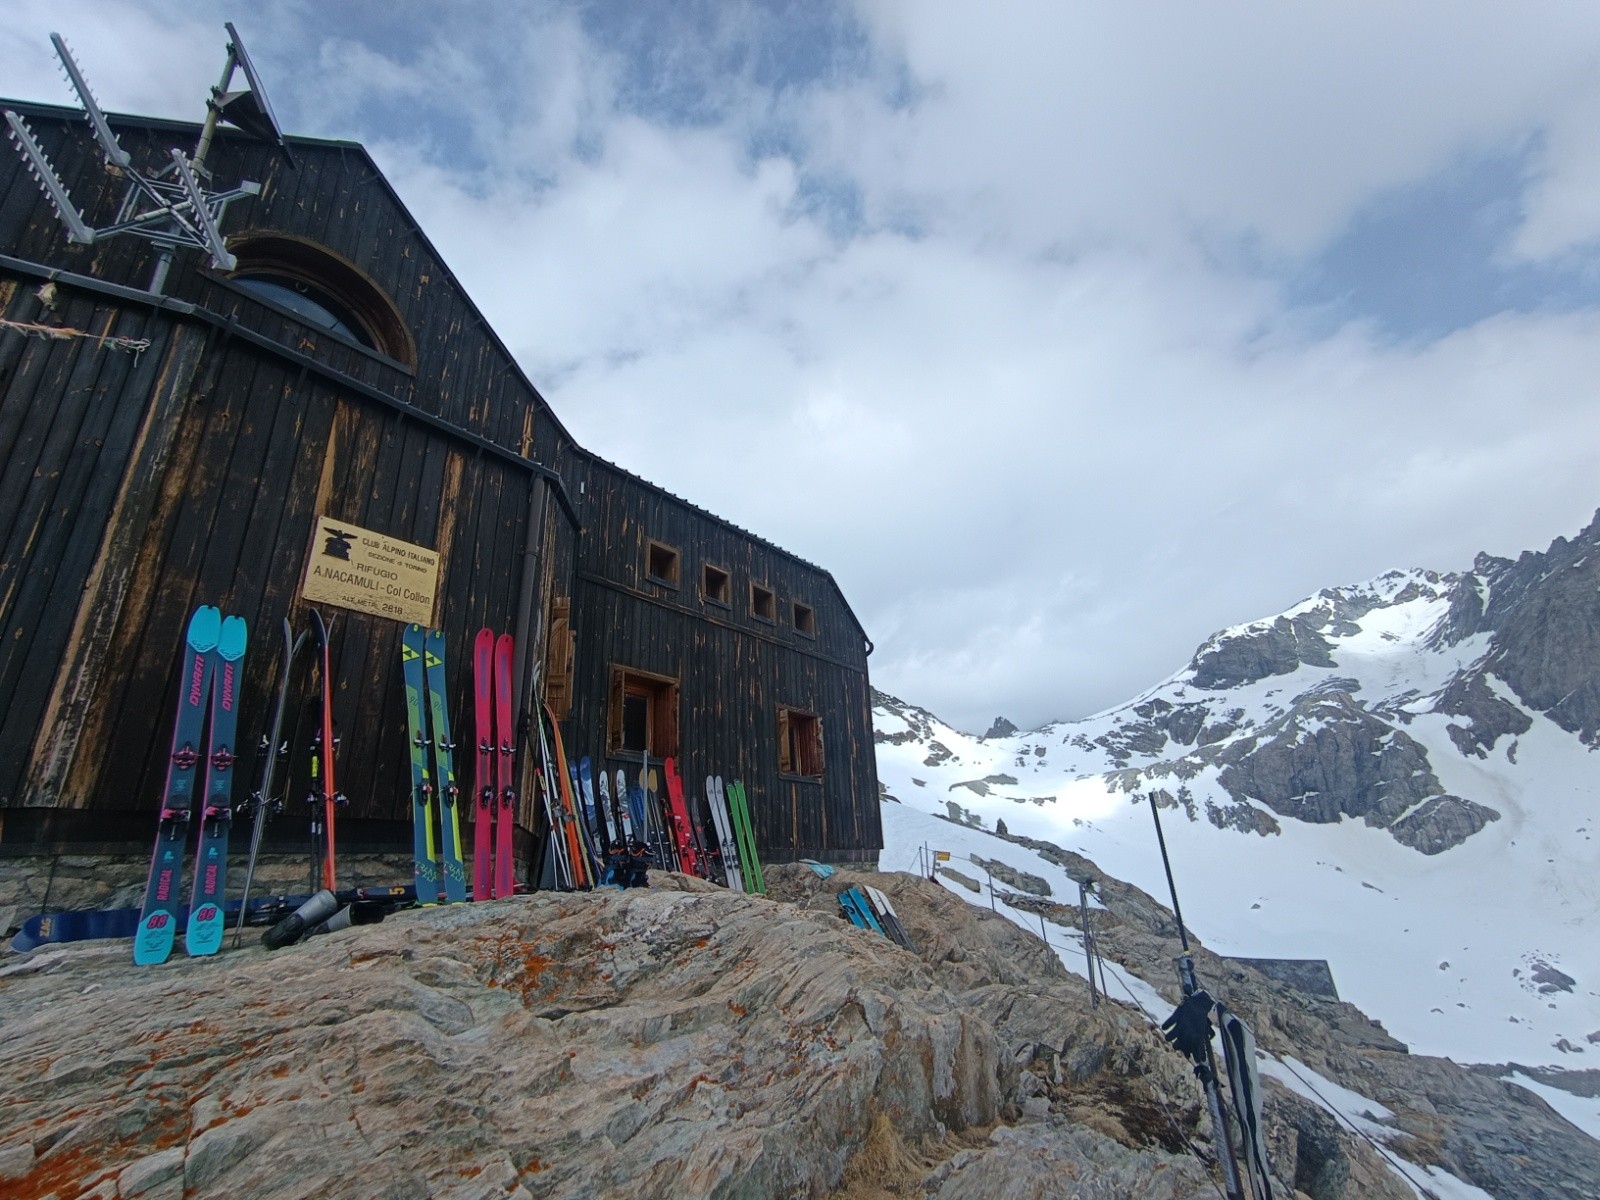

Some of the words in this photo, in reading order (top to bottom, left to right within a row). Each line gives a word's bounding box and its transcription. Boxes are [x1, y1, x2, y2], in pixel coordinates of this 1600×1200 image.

[362, 537, 380, 548] CLUB
[382, 544, 406, 557] ALPINO
[408, 551, 435, 566] ITALIANO
[357, 563, 398, 581] RIFUGIO
[386, 584, 402, 597] Col
[403, 589, 430, 604] Collon
[382, 603, 403, 615] 2818
[189, 653, 204, 706] DYNAFIT
[222, 662, 234, 712] DYNAFIT
[157, 868, 172, 901] RADICAL
[204, 864, 218, 895] RADICAL
[147, 914, 168, 929] 88
[197, 907, 217, 922] 88
[39, 917, 51, 937] ZAG
